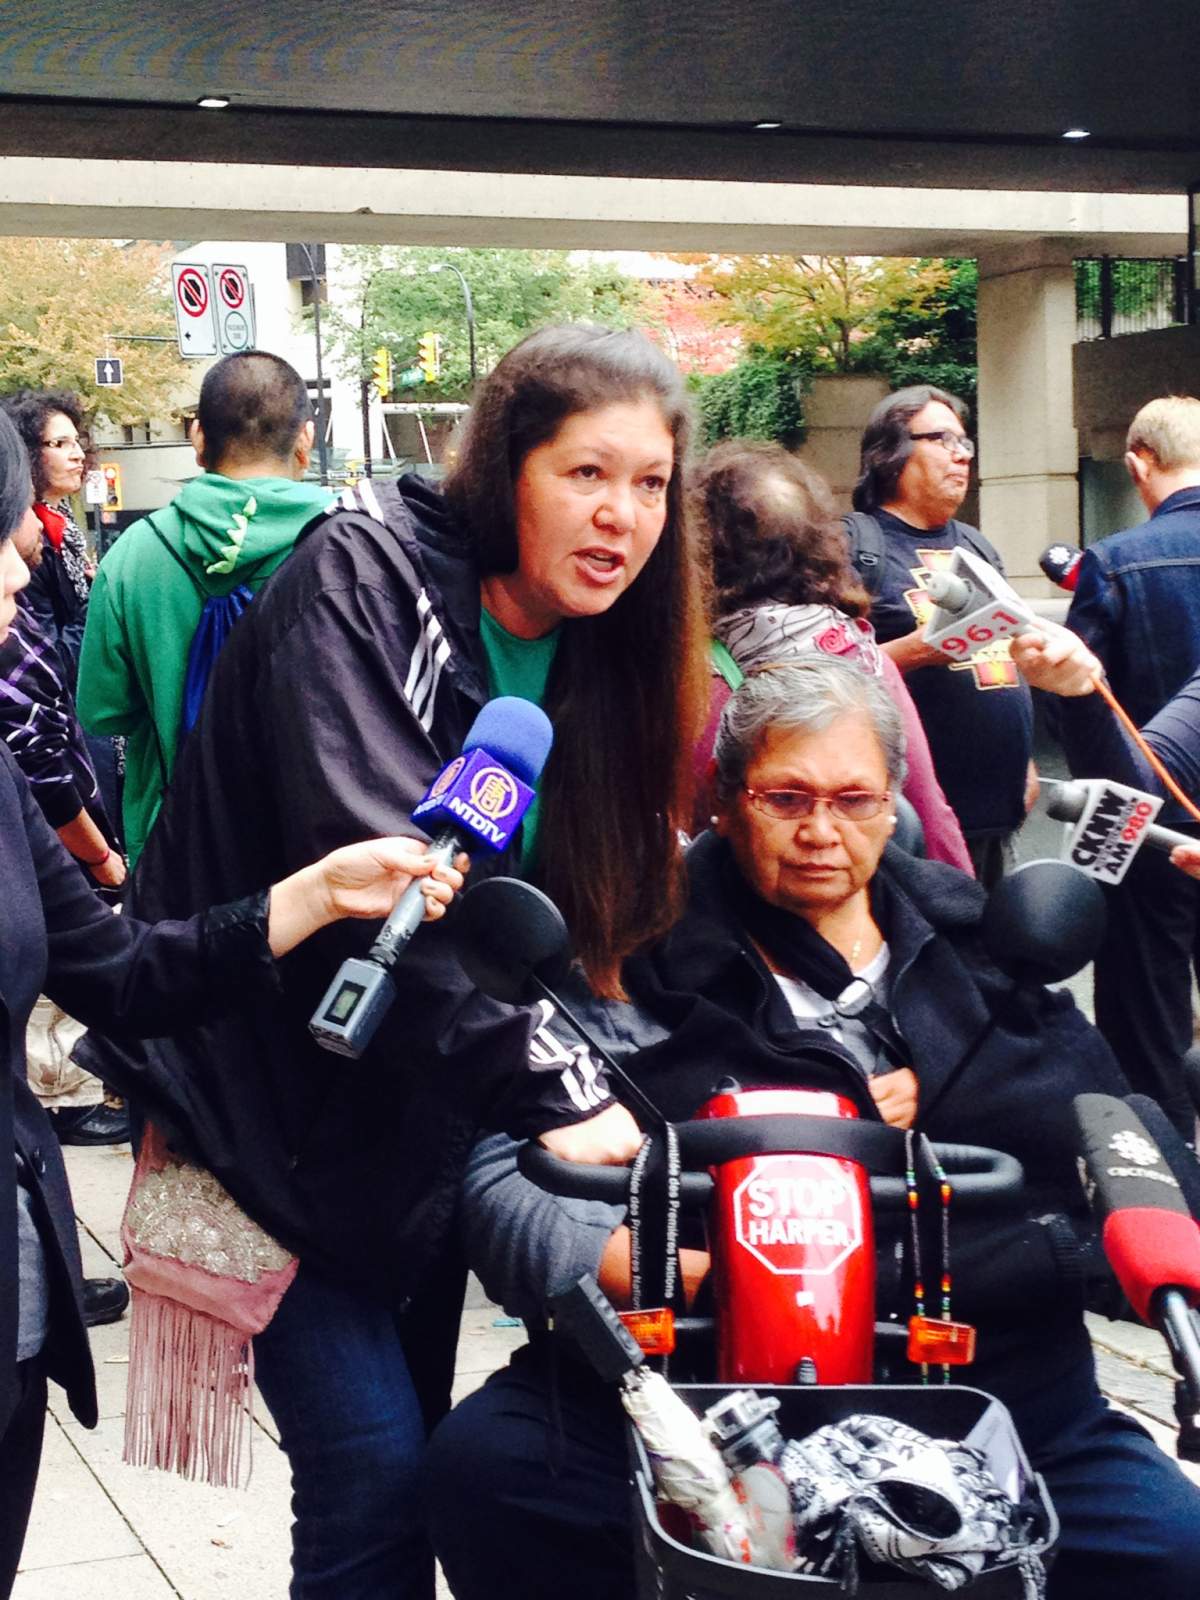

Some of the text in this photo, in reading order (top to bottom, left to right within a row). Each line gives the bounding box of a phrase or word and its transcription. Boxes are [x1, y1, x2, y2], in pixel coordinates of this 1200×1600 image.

[941, 610, 1019, 655] 96.1
[448, 796, 506, 843] NTDTV
[1072, 787, 1128, 866] CKNW
[1105, 842, 1134, 876] AM
[1121, 801, 1153, 842] 980
[746, 1178, 846, 1218] STOP
[748, 1217, 852, 1247] HARPER
[664, 1256, 678, 1298] Nations
